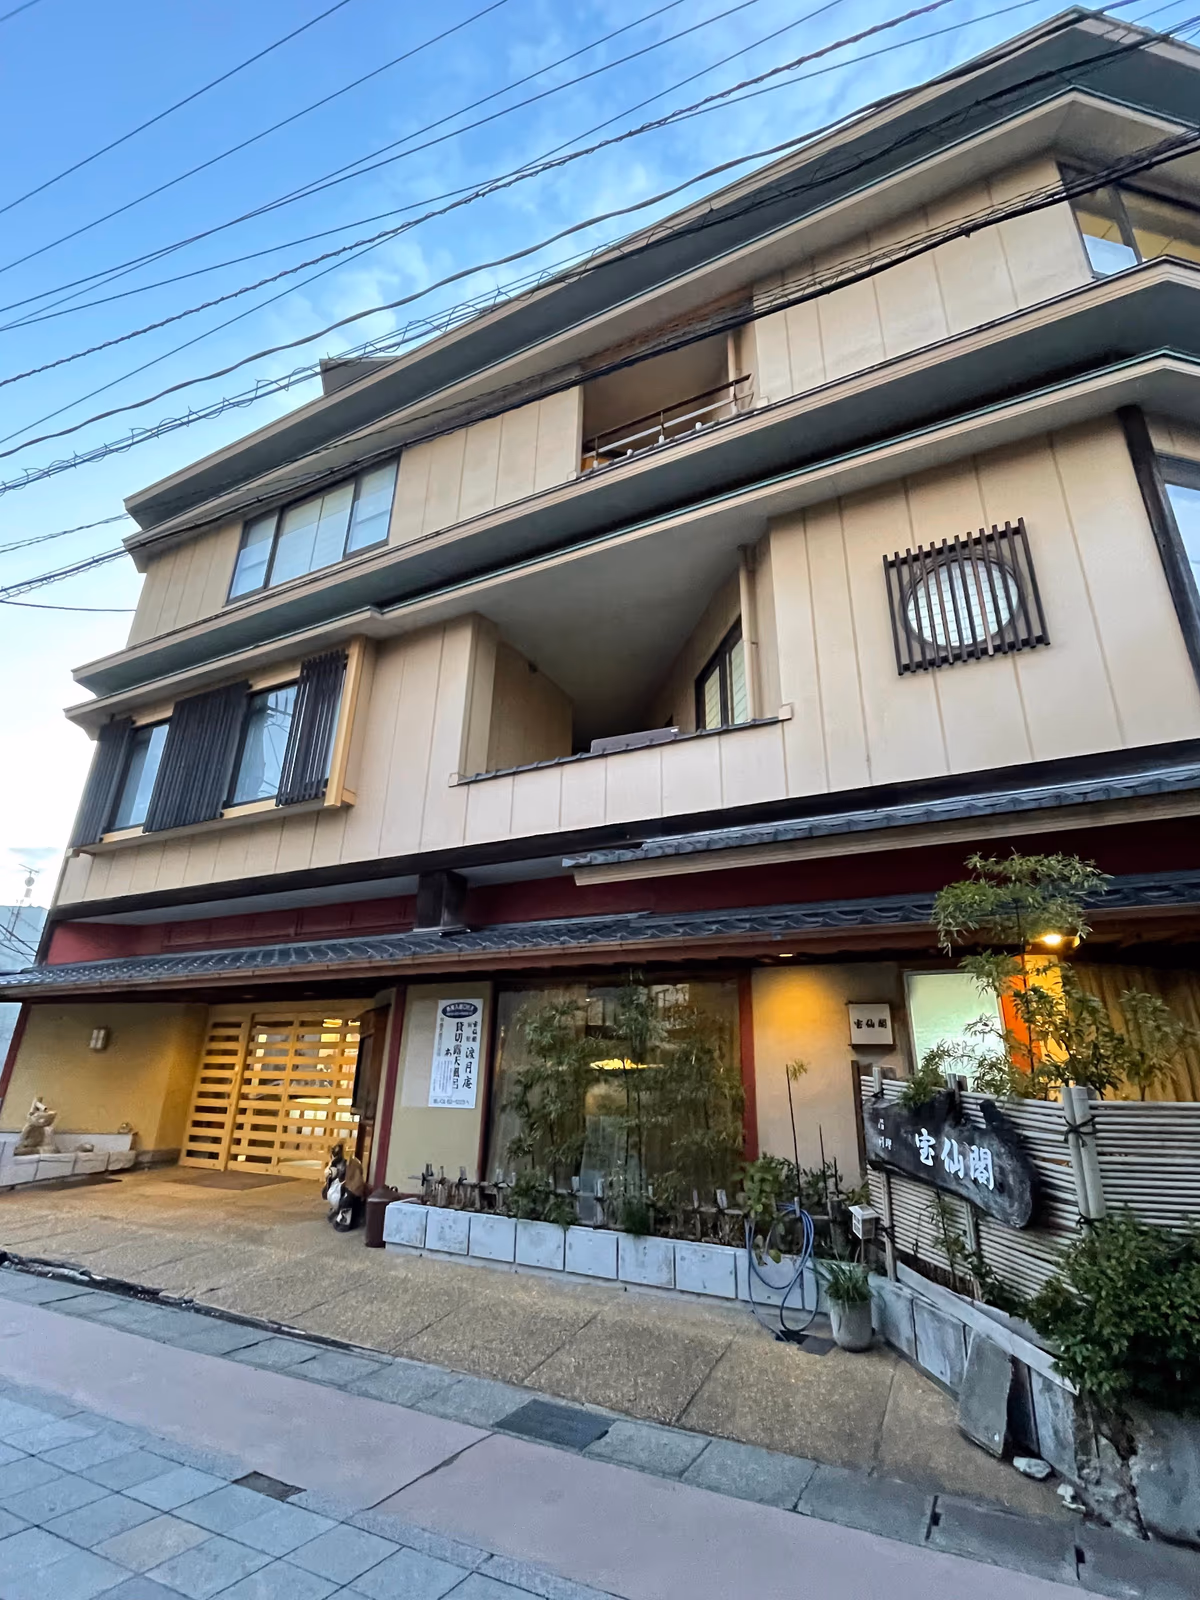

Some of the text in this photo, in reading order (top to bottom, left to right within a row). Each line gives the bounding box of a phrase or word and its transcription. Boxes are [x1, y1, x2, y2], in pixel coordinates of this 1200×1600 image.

[853, 1018, 888, 1029] 宝仙閣
[462, 1046, 475, 1089] 渡月庵
[914, 1128, 994, 1190] 宝仙閣
